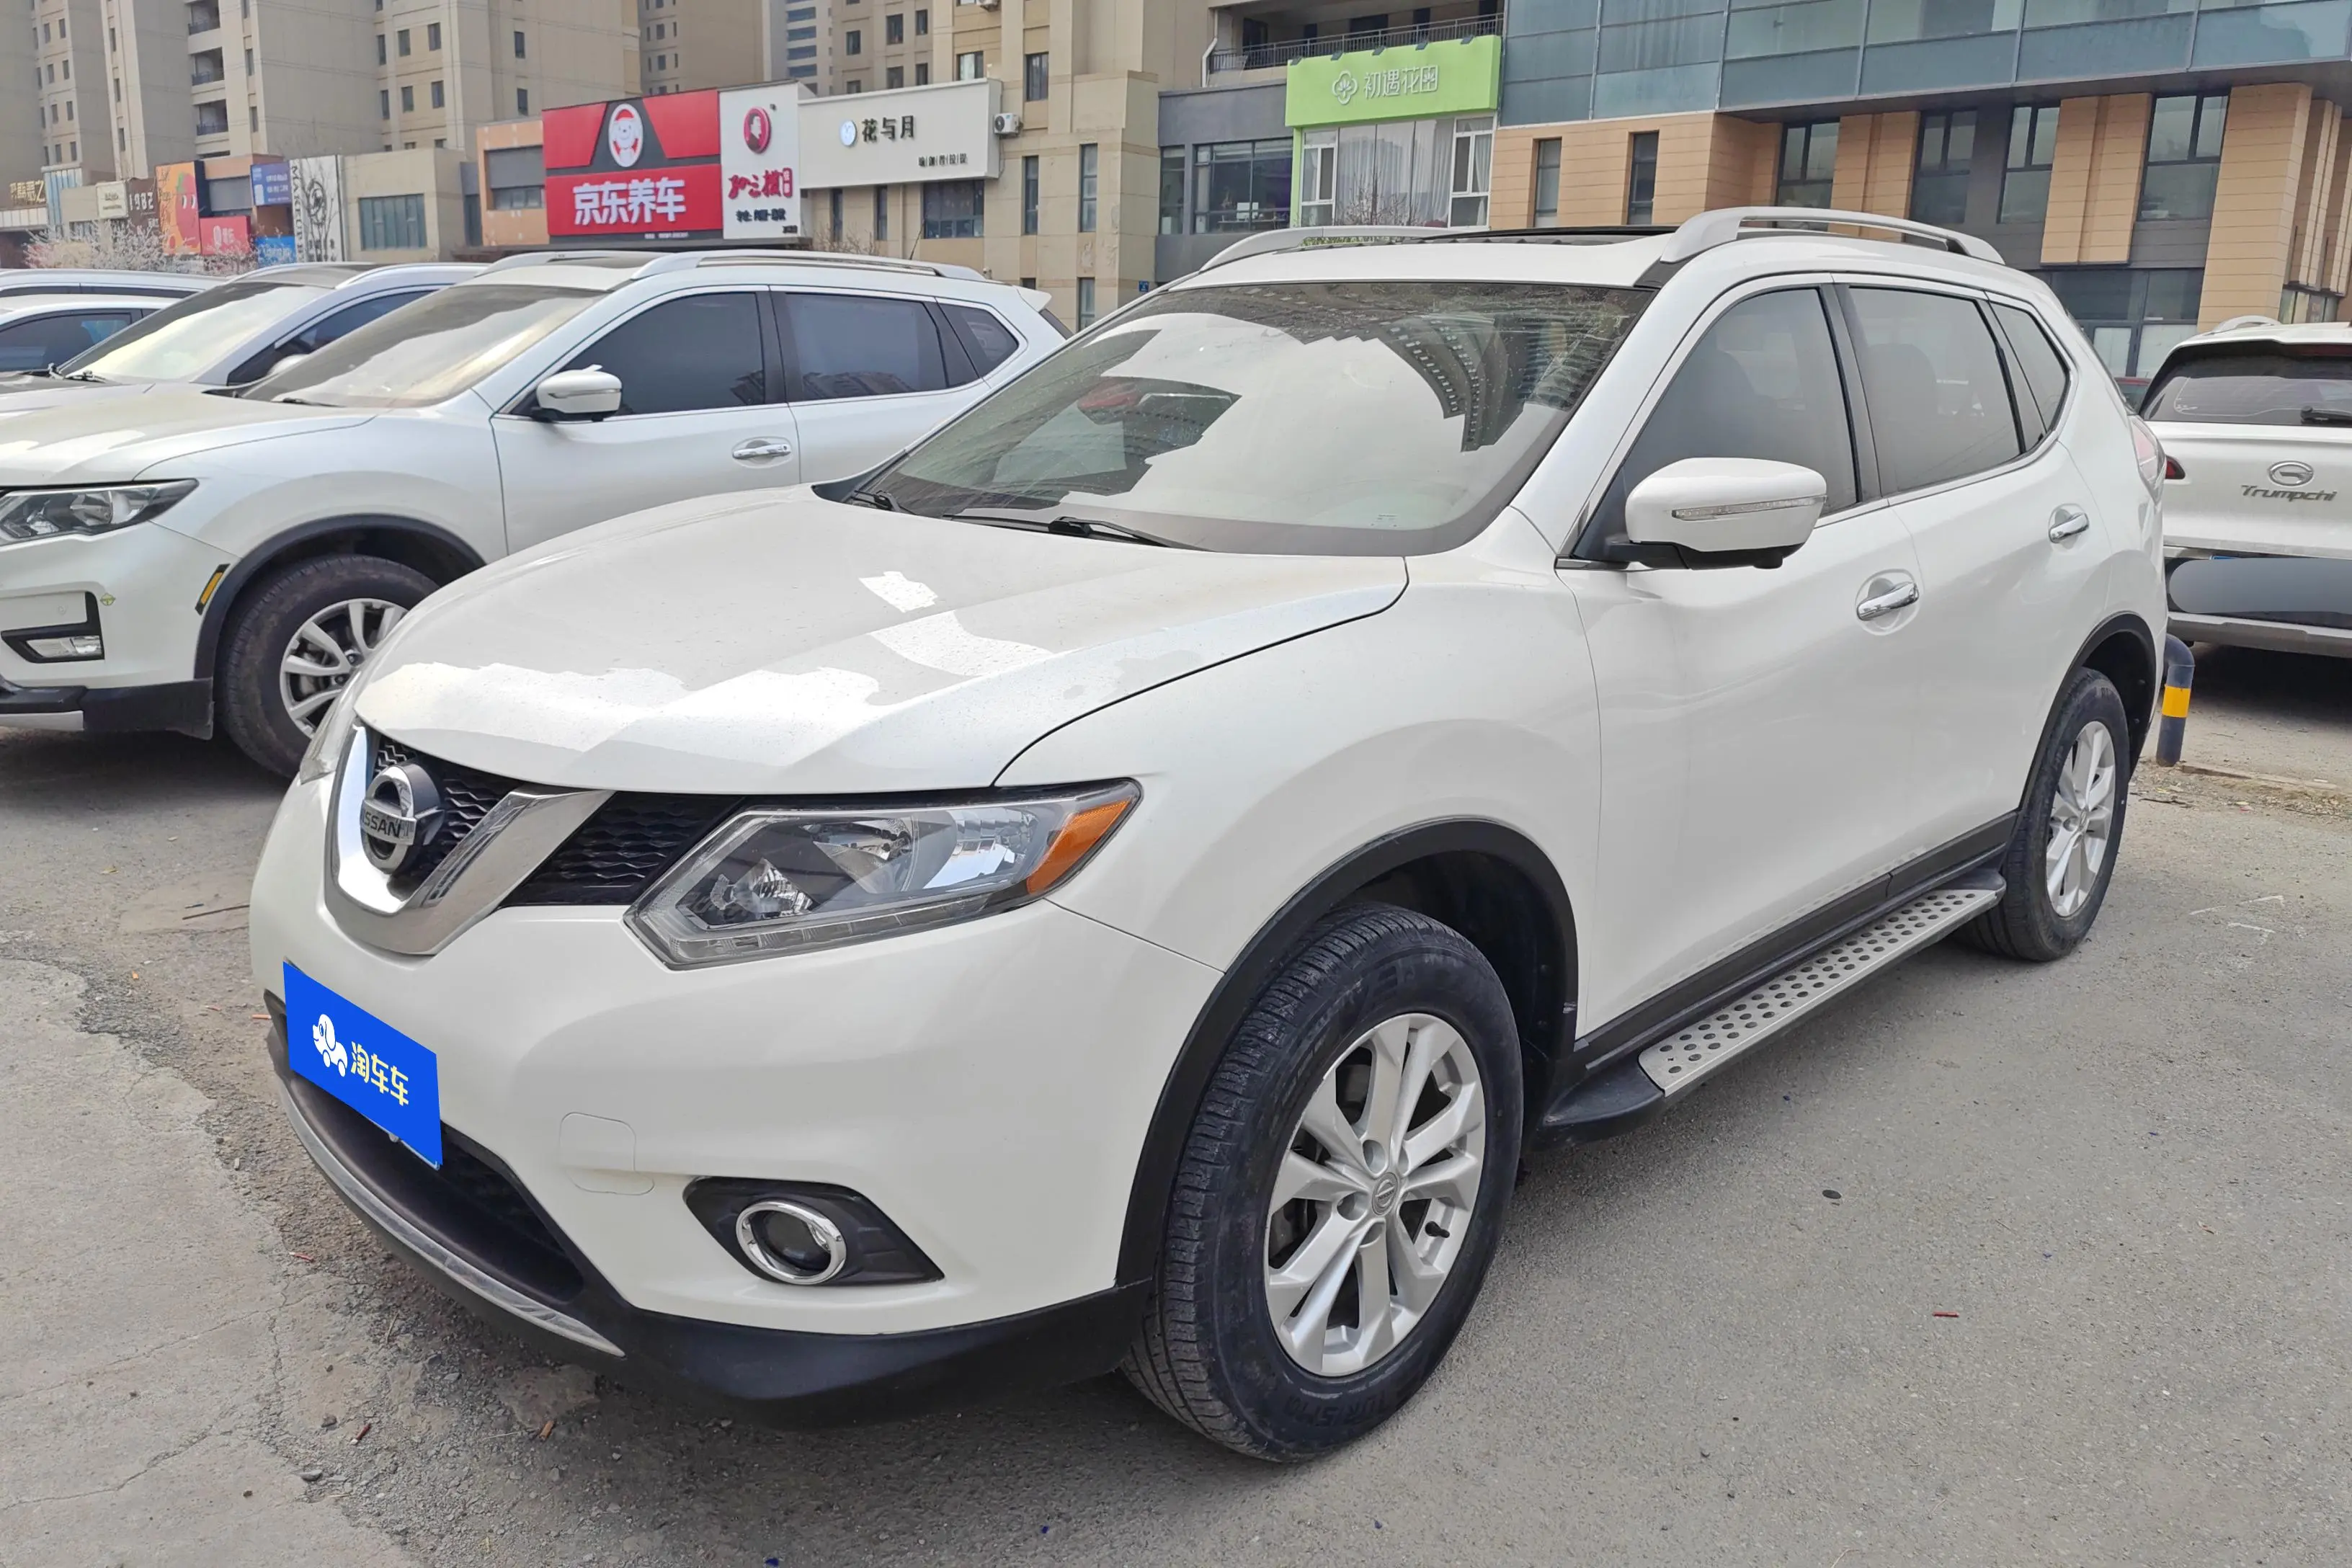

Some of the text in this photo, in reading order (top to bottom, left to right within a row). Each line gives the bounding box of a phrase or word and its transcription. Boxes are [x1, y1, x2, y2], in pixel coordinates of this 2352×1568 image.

[1364, 65, 1438, 99] 初遇花田
[862, 115, 914, 142] 花与月
[129, 192, 154, 211] 1982
[573, 177, 686, 225] 京东养车
[2241, 485, 2338, 502] Trumpchi
